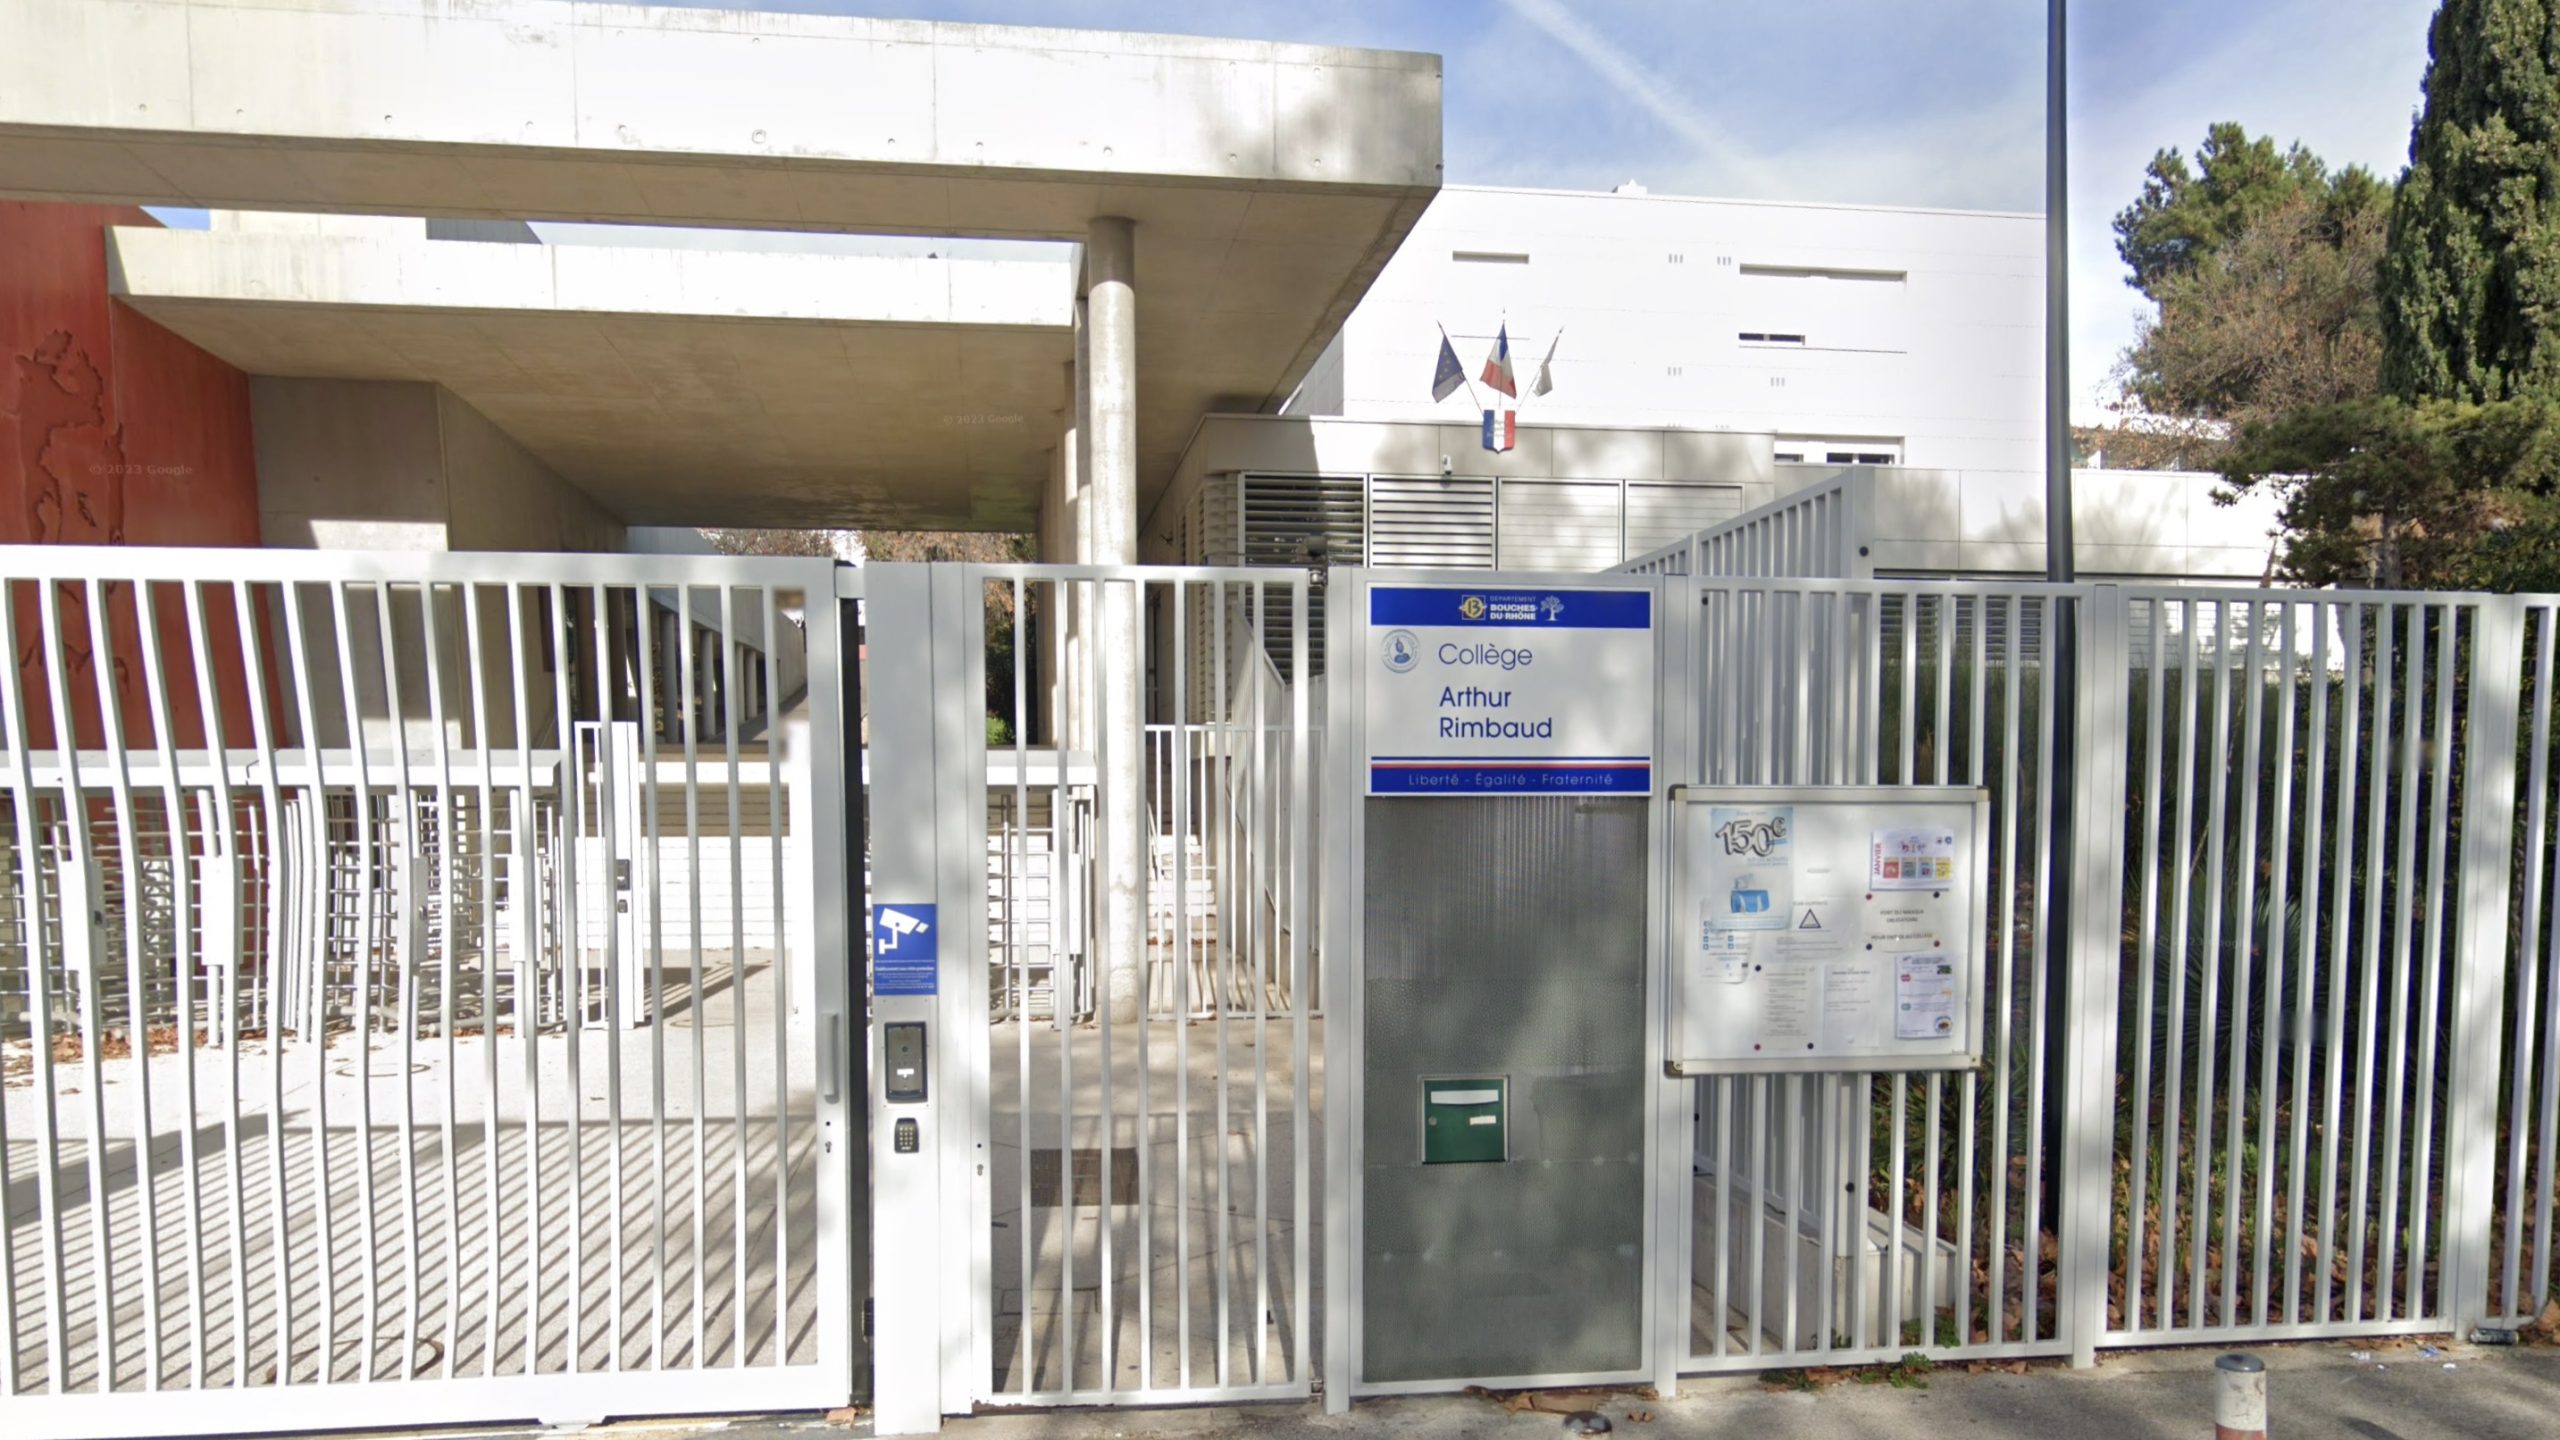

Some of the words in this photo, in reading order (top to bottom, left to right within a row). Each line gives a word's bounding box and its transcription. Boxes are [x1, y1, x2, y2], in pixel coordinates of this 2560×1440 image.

[1438, 643, 1533, 671] Collège
[1439, 686, 1512, 707] Arthur
[1439, 717, 1552, 738] Rimbaud
[1408, 773, 1459, 786] Liberté
[1475, 771, 1526, 787] Égalité
[1541, 773, 1614, 786] Fraternité
[1714, 816, 1787, 857] 150€
